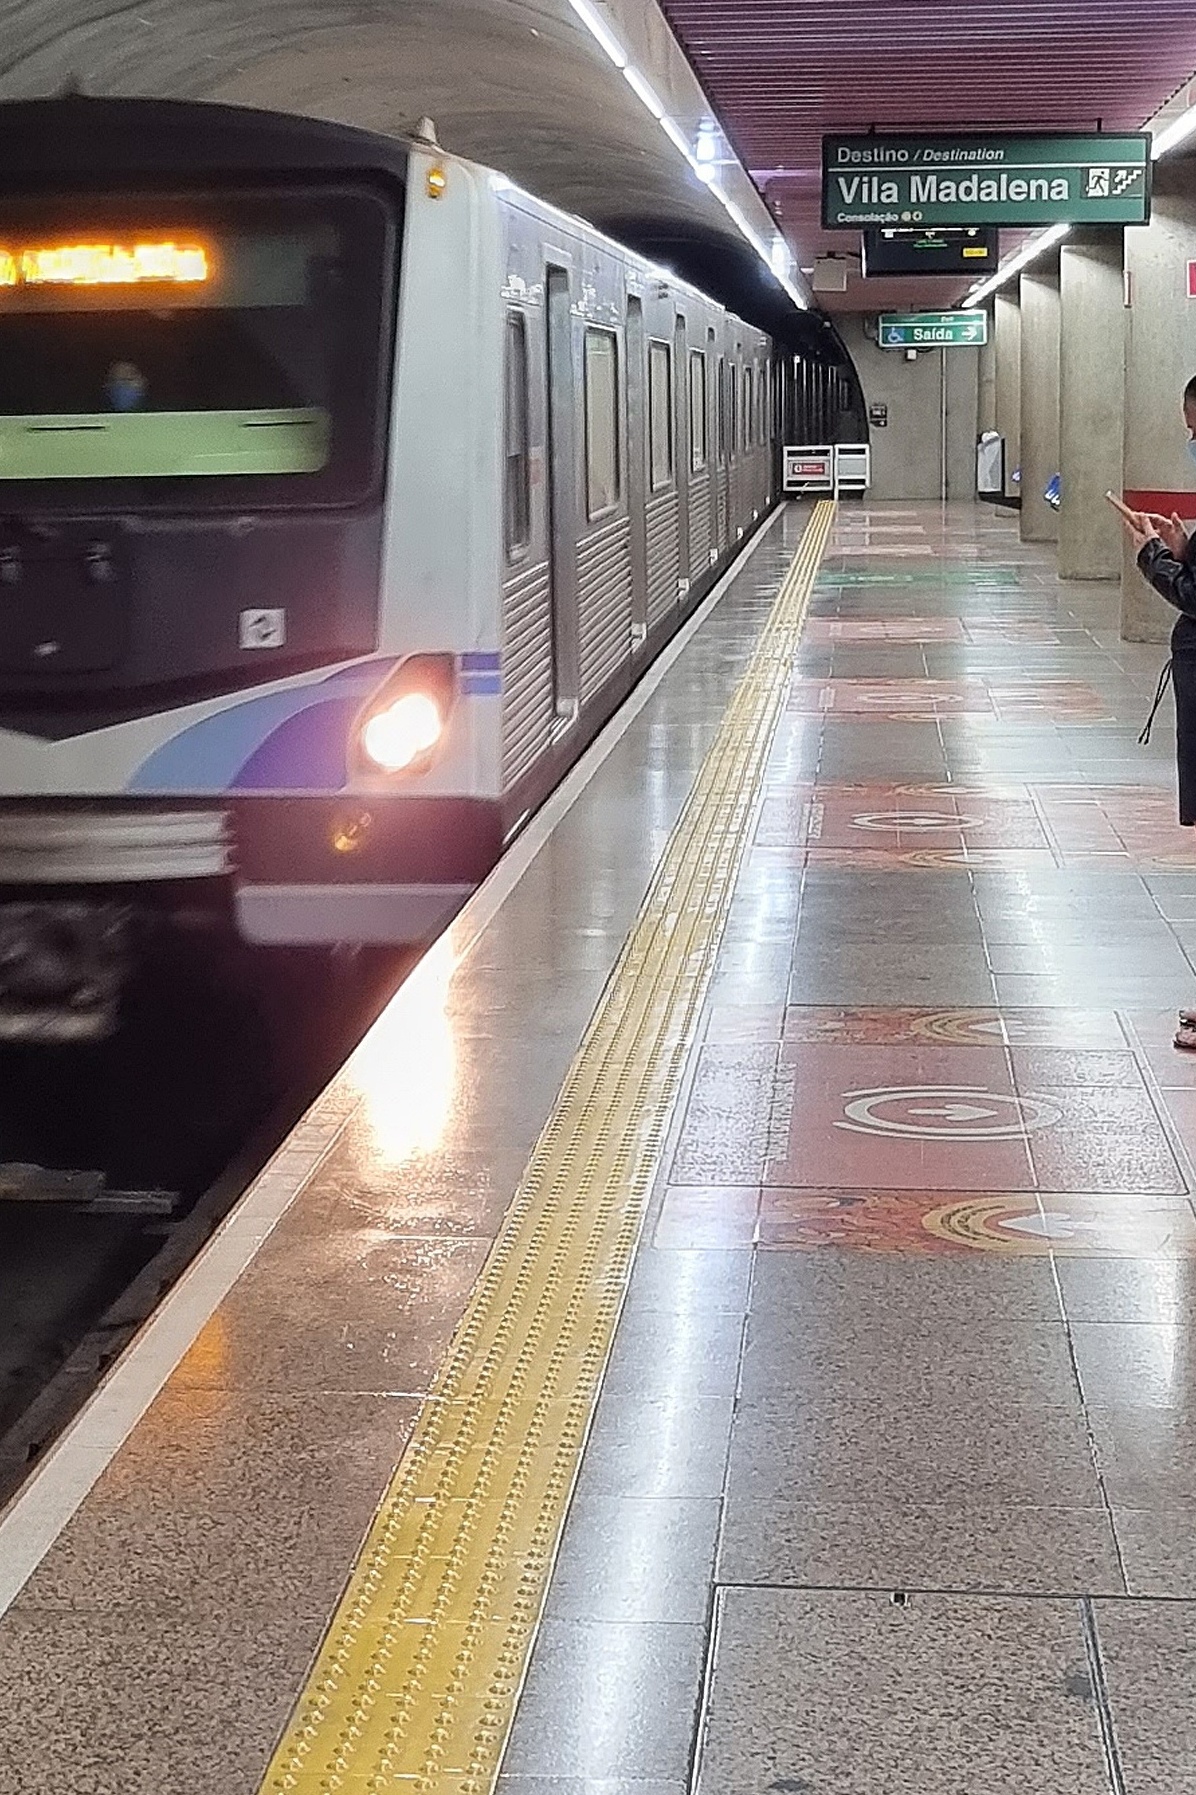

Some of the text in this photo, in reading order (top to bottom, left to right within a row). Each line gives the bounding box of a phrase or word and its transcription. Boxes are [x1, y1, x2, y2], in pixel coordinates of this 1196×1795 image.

[837, 147, 909, 163] Destino
[922, 148, 1005, 162] Destination
[837, 173, 1069, 204] Vila Madalena
